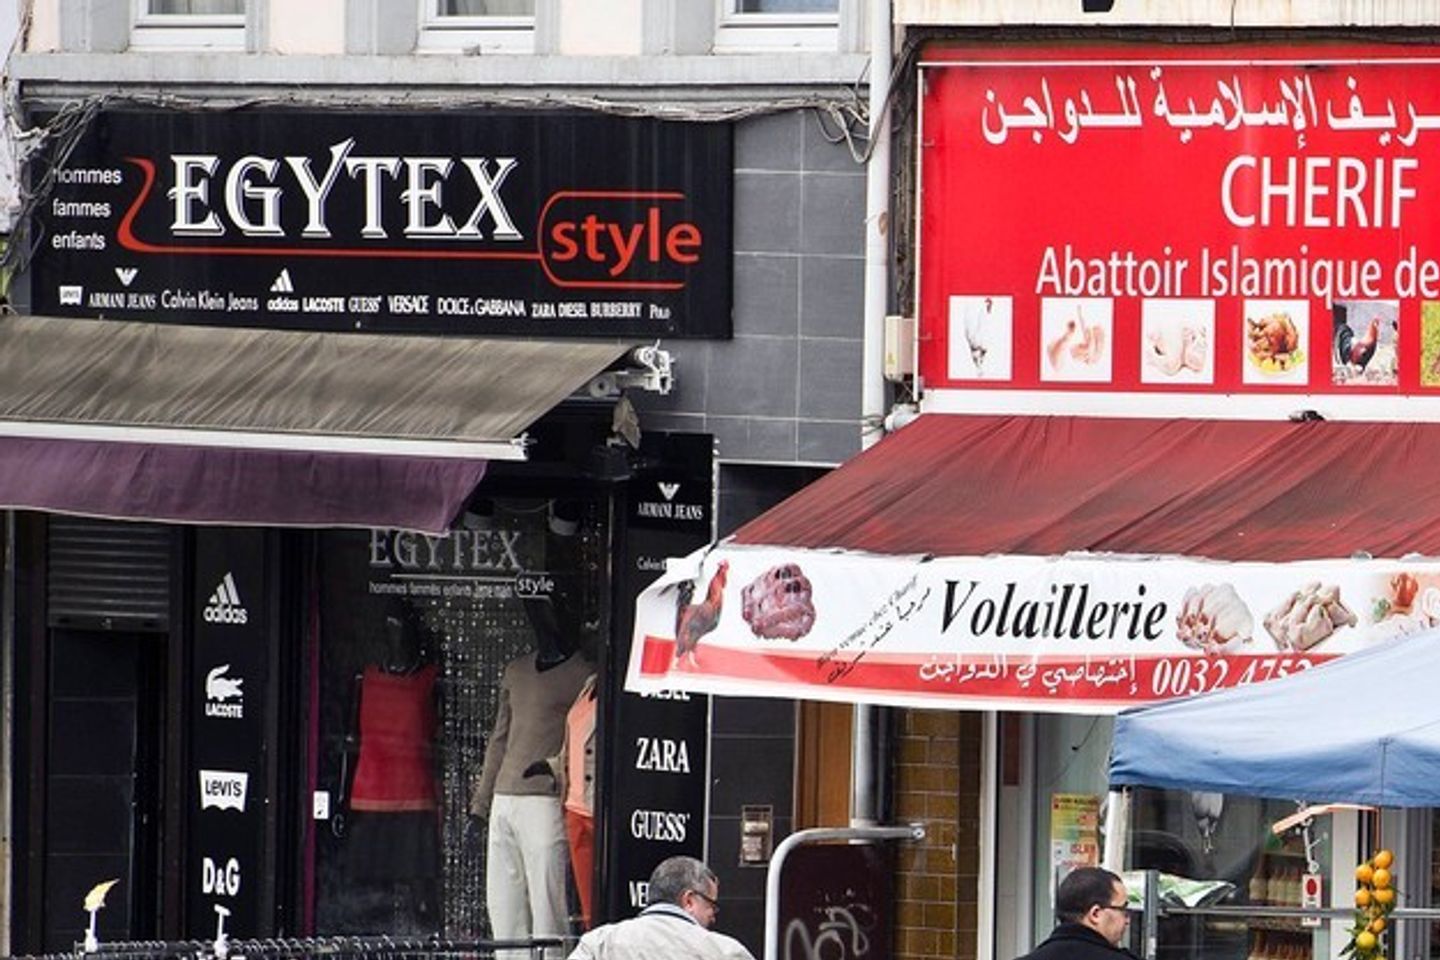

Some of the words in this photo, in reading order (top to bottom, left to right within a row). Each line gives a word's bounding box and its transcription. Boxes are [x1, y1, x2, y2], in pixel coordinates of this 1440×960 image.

[981, 75, 1143, 144] للدواجن
[1150, 66, 1318, 149] الإسلامية
[167, 137, 524, 241] EGYTEX
[1221, 155, 1418, 228] CHERIF
[52, 229, 107, 250] enfants
[551, 208, 702, 277] style
[1036, 245, 1188, 297] Abattoir
[1201, 245, 1382, 309] Islamique
[1394, 246, 1440, 298] de
[160, 289, 197, 310] Calvin
[198, 290, 225, 311] Klein
[267, 298, 299, 312] adidas
[302, 297, 345, 313] LACOSTE
[387, 295, 429, 314] VERSACE
[531, 303, 556, 318] ZARA
[558, 302, 588, 318] DIESEL
[590, 302, 642, 318] BURBERRY
[637, 503, 673, 518] ARMANI
[674, 504, 703, 520] JEANS
[368, 528, 521, 571] EGYTEX
[518, 575, 555, 594] style
[203, 605, 248, 625] adidas
[941, 578, 1168, 642] Volaillerie
[919, 652, 1008, 684] الدواجن
[1151, 658, 1229, 696] 0032
[205, 703, 243, 719] LACOSTE
[635, 737, 691, 774] ZARA
[202, 857, 241, 897] D&G
